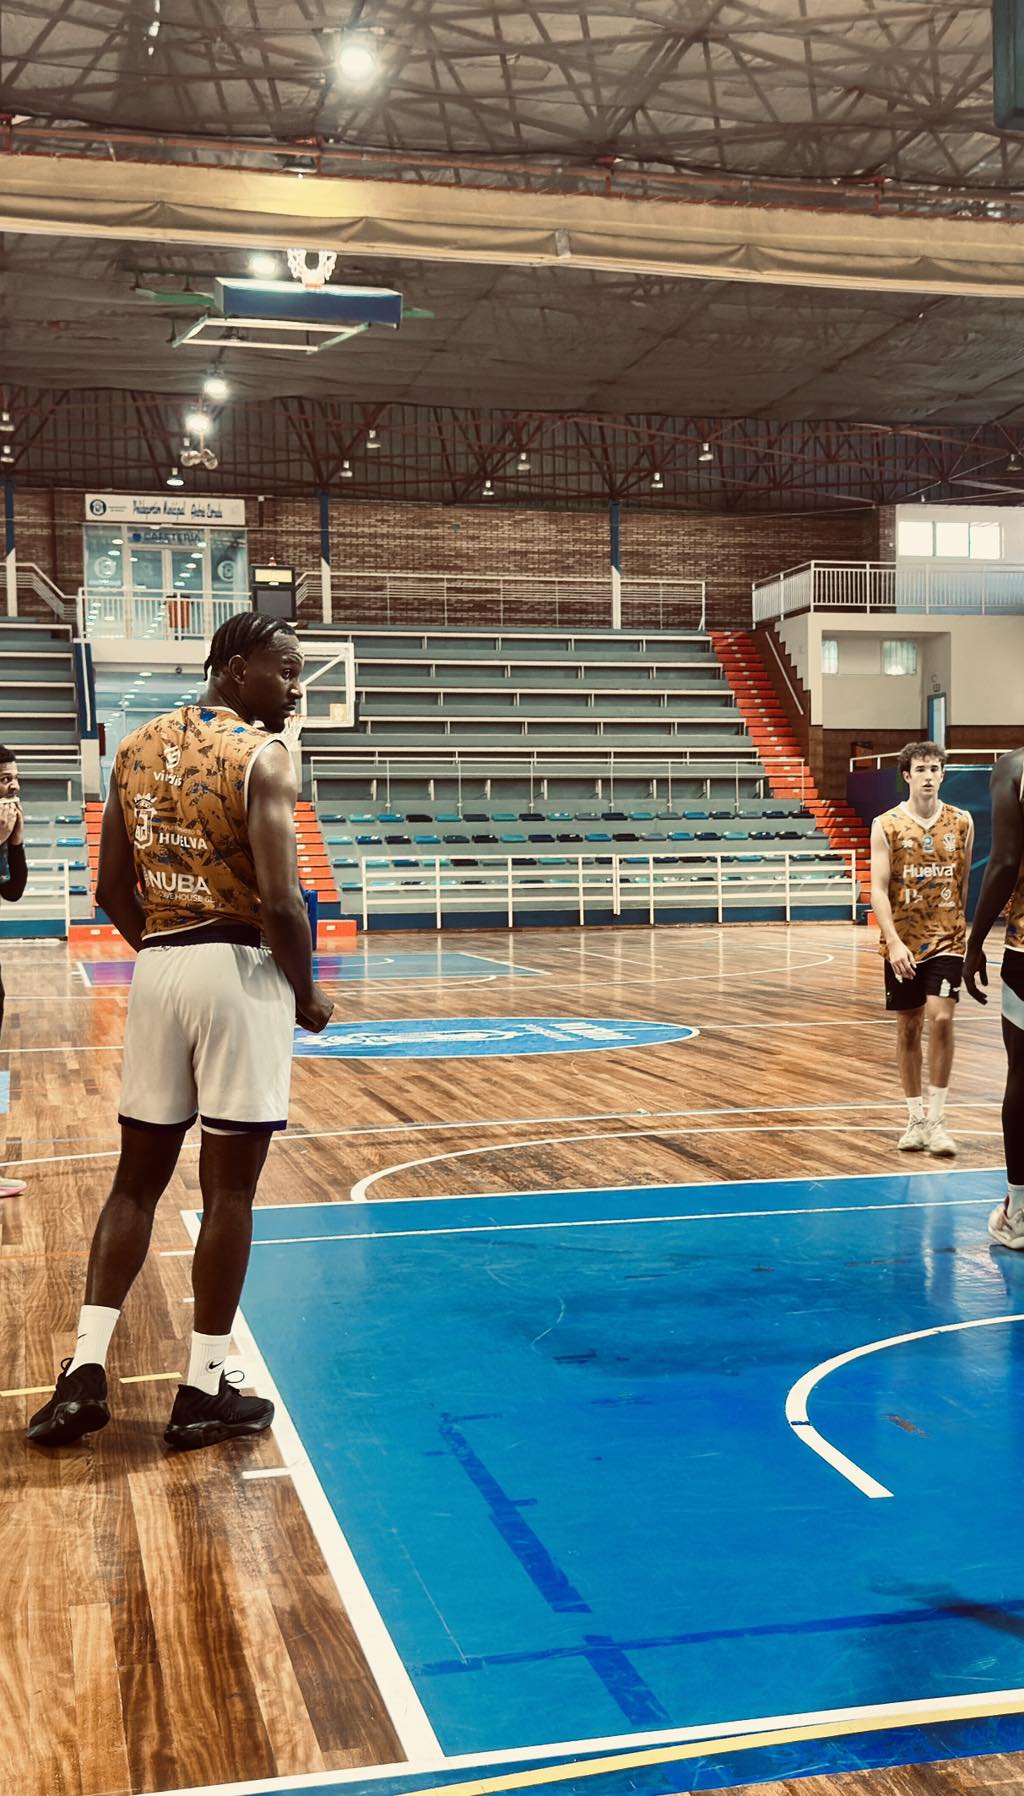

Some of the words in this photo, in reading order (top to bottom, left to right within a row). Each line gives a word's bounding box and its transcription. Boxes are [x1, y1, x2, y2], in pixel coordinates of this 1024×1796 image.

[159, 832, 208, 850] HUELVA
[902, 863, 955, 879] Huelva
[147, 869, 212, 895] NUBA
